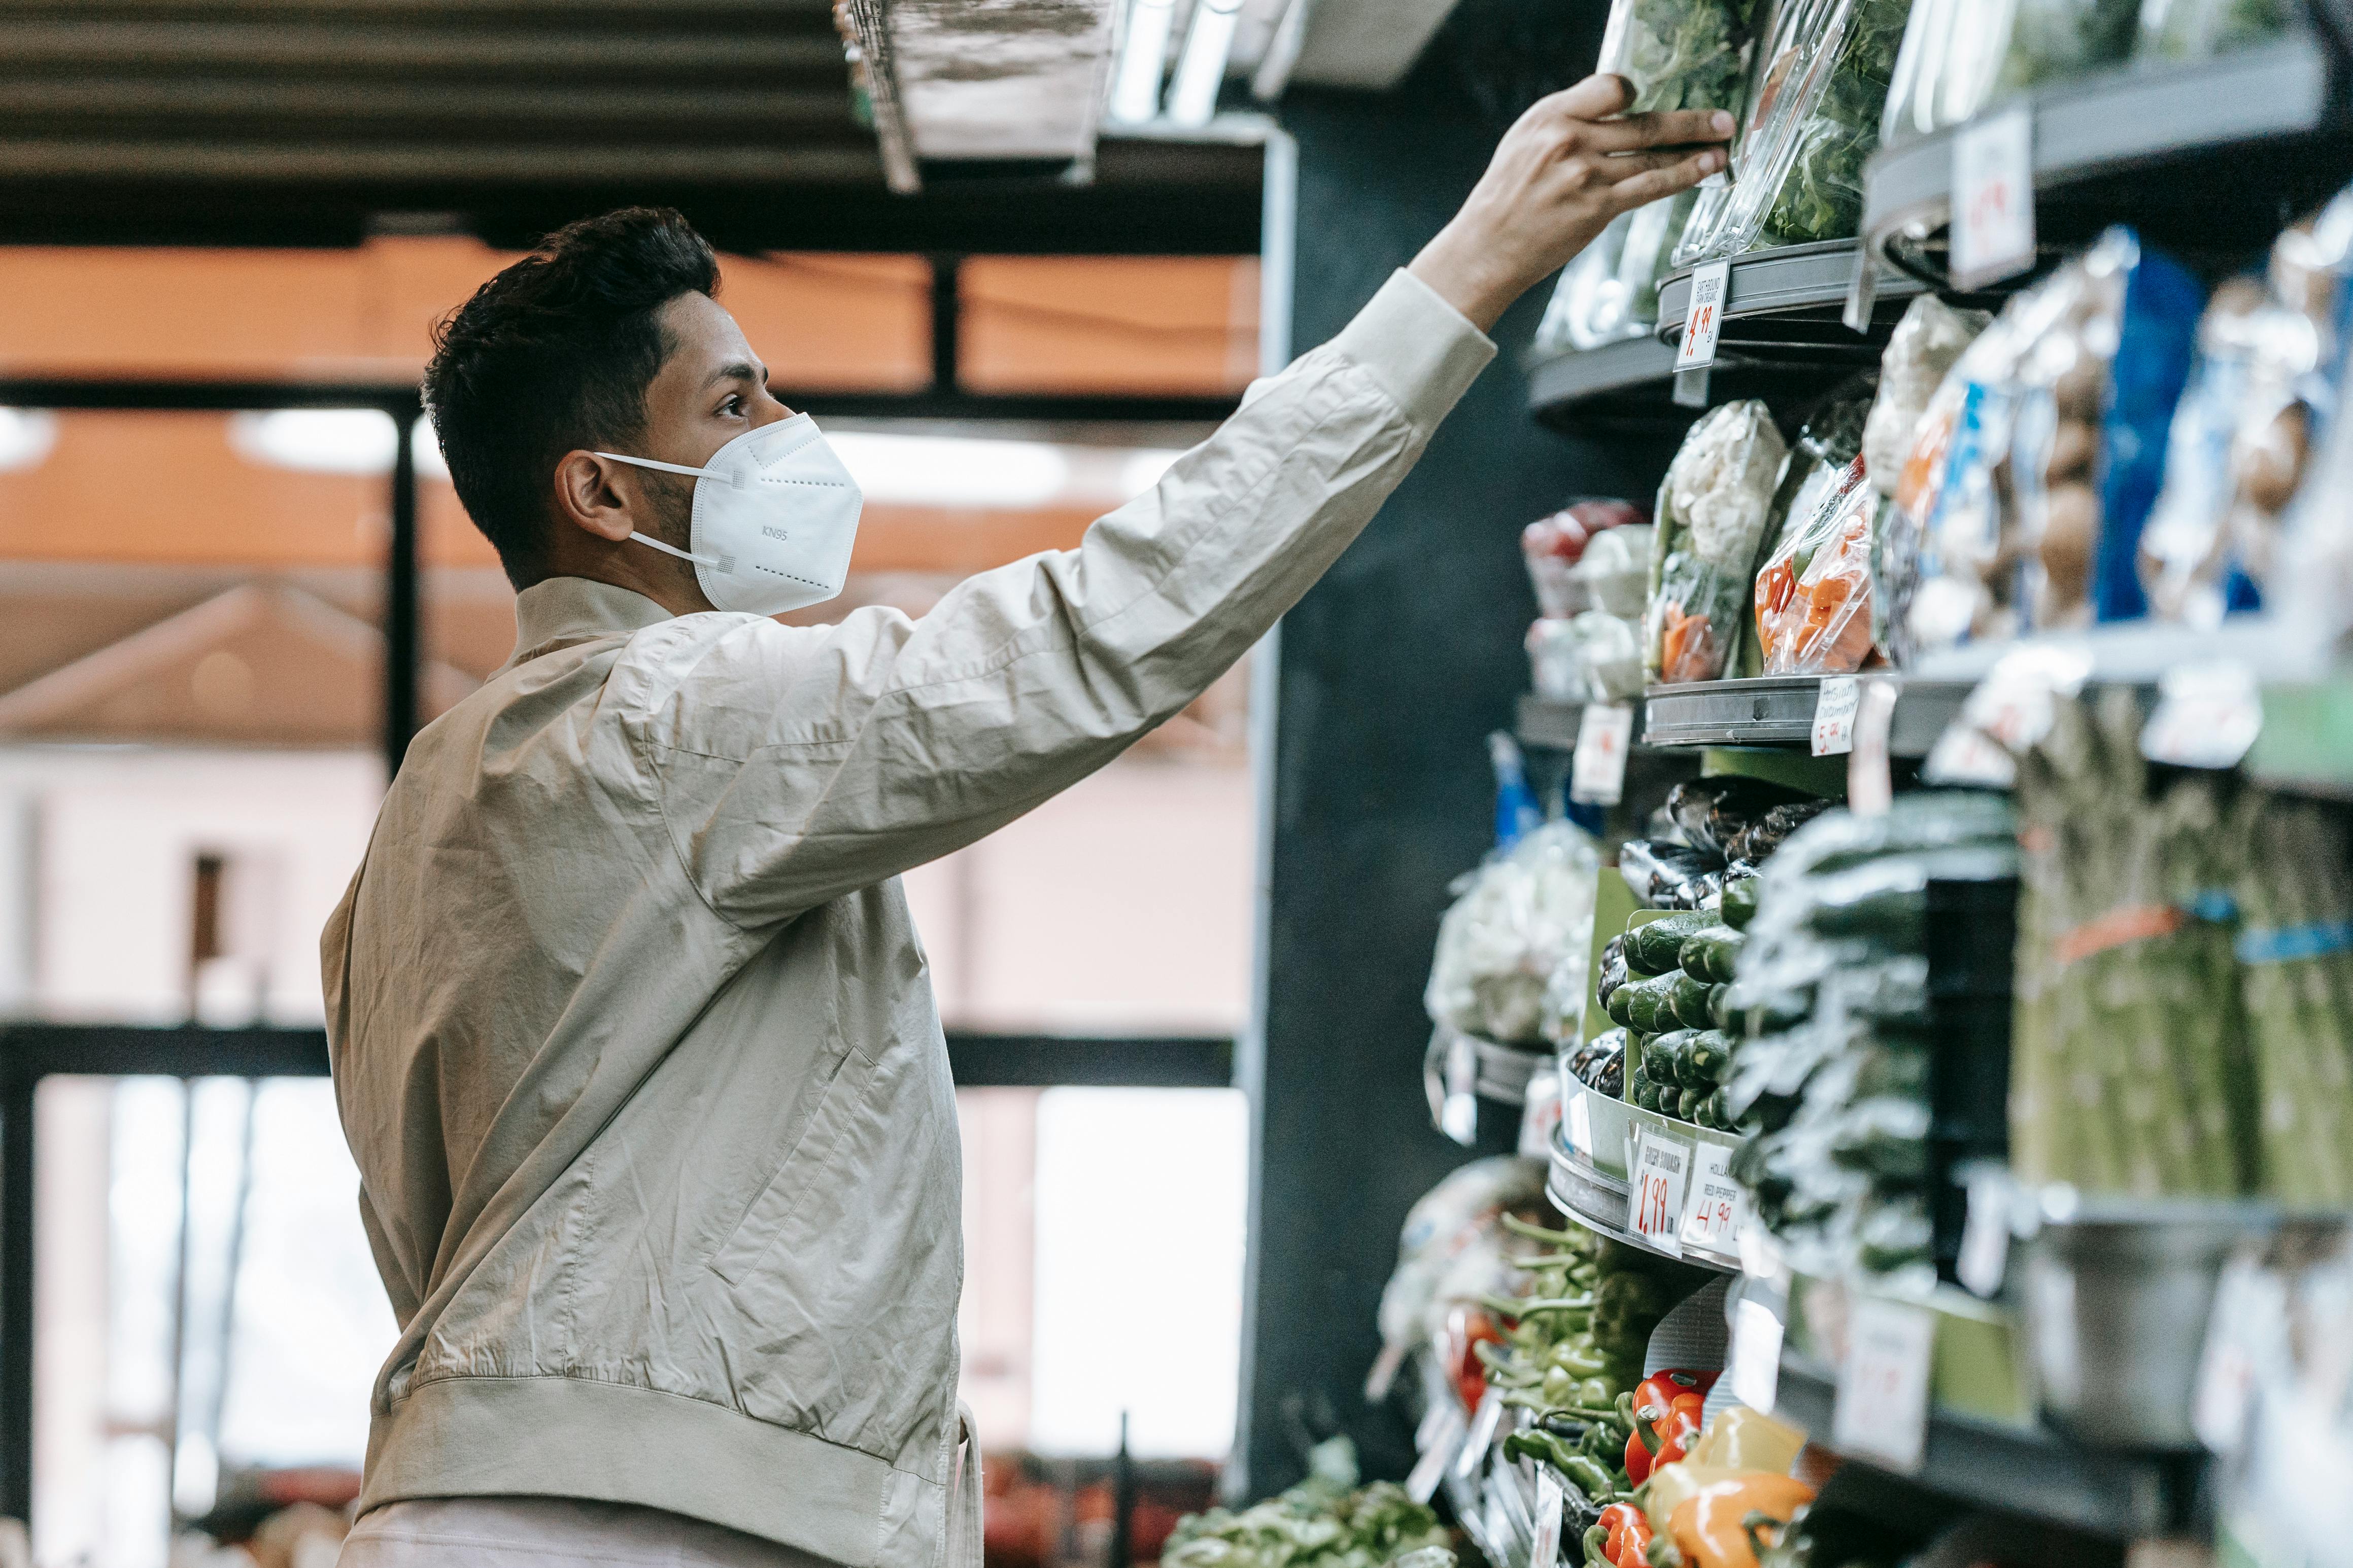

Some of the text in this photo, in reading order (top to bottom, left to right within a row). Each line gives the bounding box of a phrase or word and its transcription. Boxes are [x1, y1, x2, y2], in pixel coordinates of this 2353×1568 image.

[1697, 277, 1720, 294] EARTHBOUND
[762, 526, 788, 541] KN95
[1704, 1183, 1737, 1202] RED PEPPER
